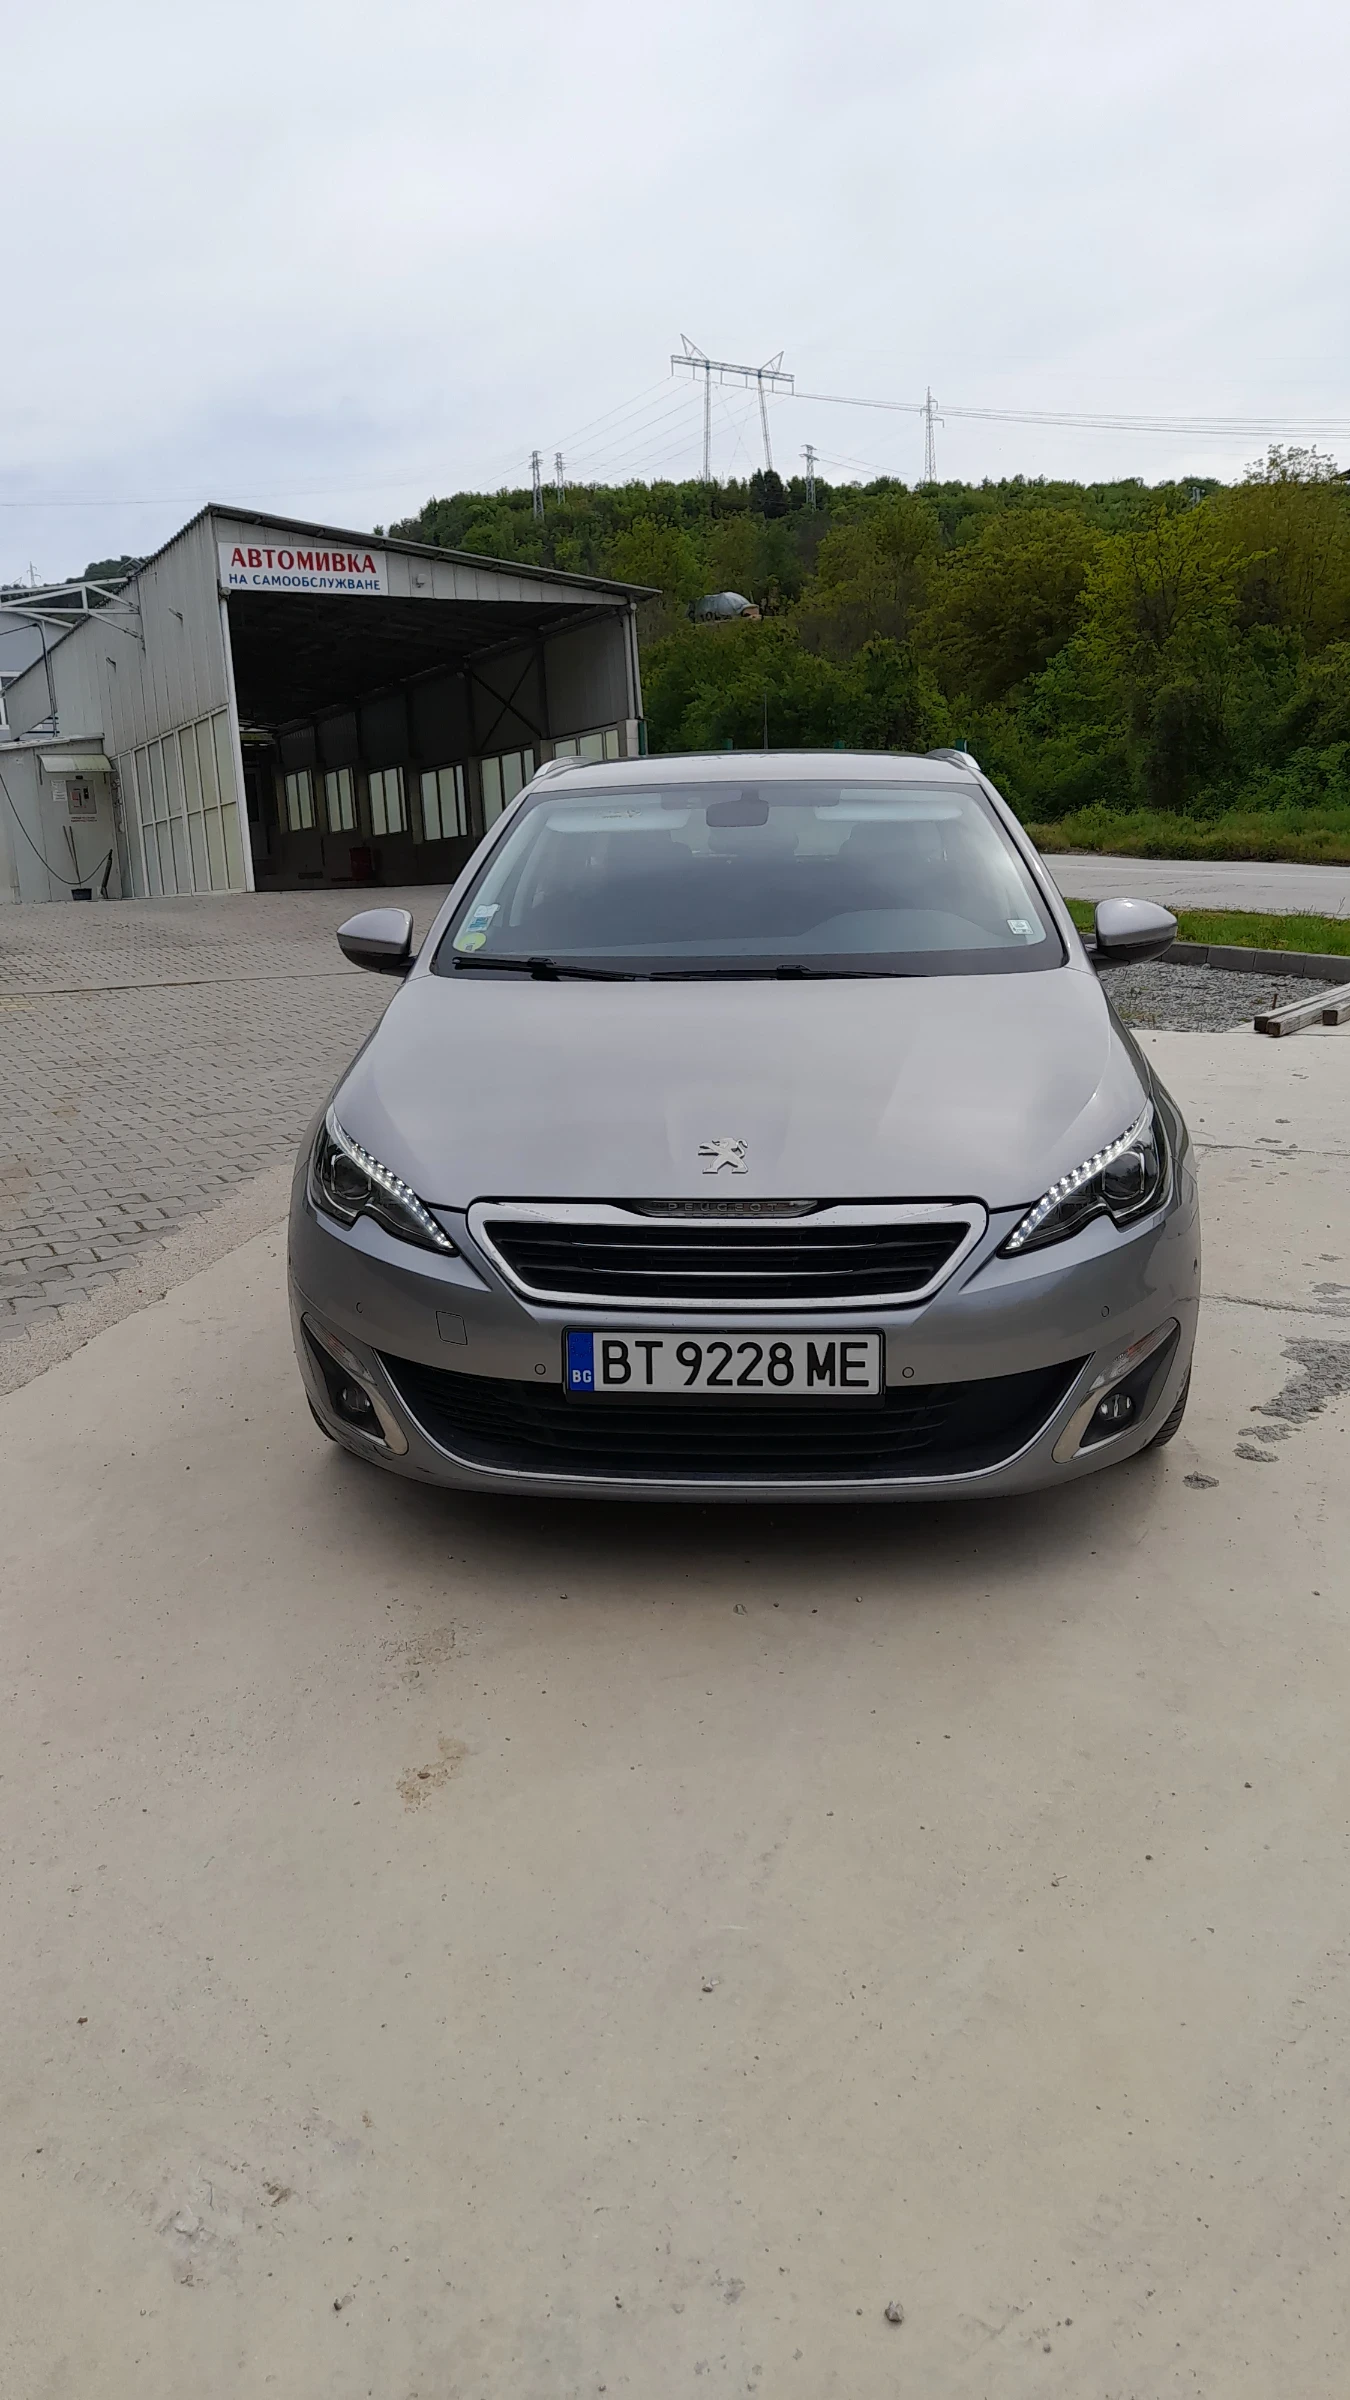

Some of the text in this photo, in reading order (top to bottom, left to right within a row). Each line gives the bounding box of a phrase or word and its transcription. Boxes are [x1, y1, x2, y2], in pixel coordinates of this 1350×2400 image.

[231, 548, 376, 573] АВТОМИВКА
[229, 574, 380, 590] НА САМООБСЛУЖВАНЕ
[668, 1203, 777, 1212] PEUGEOT
[602, 1340, 869, 1387] BT 9228 ME
[572, 1369, 592, 1383] BG
